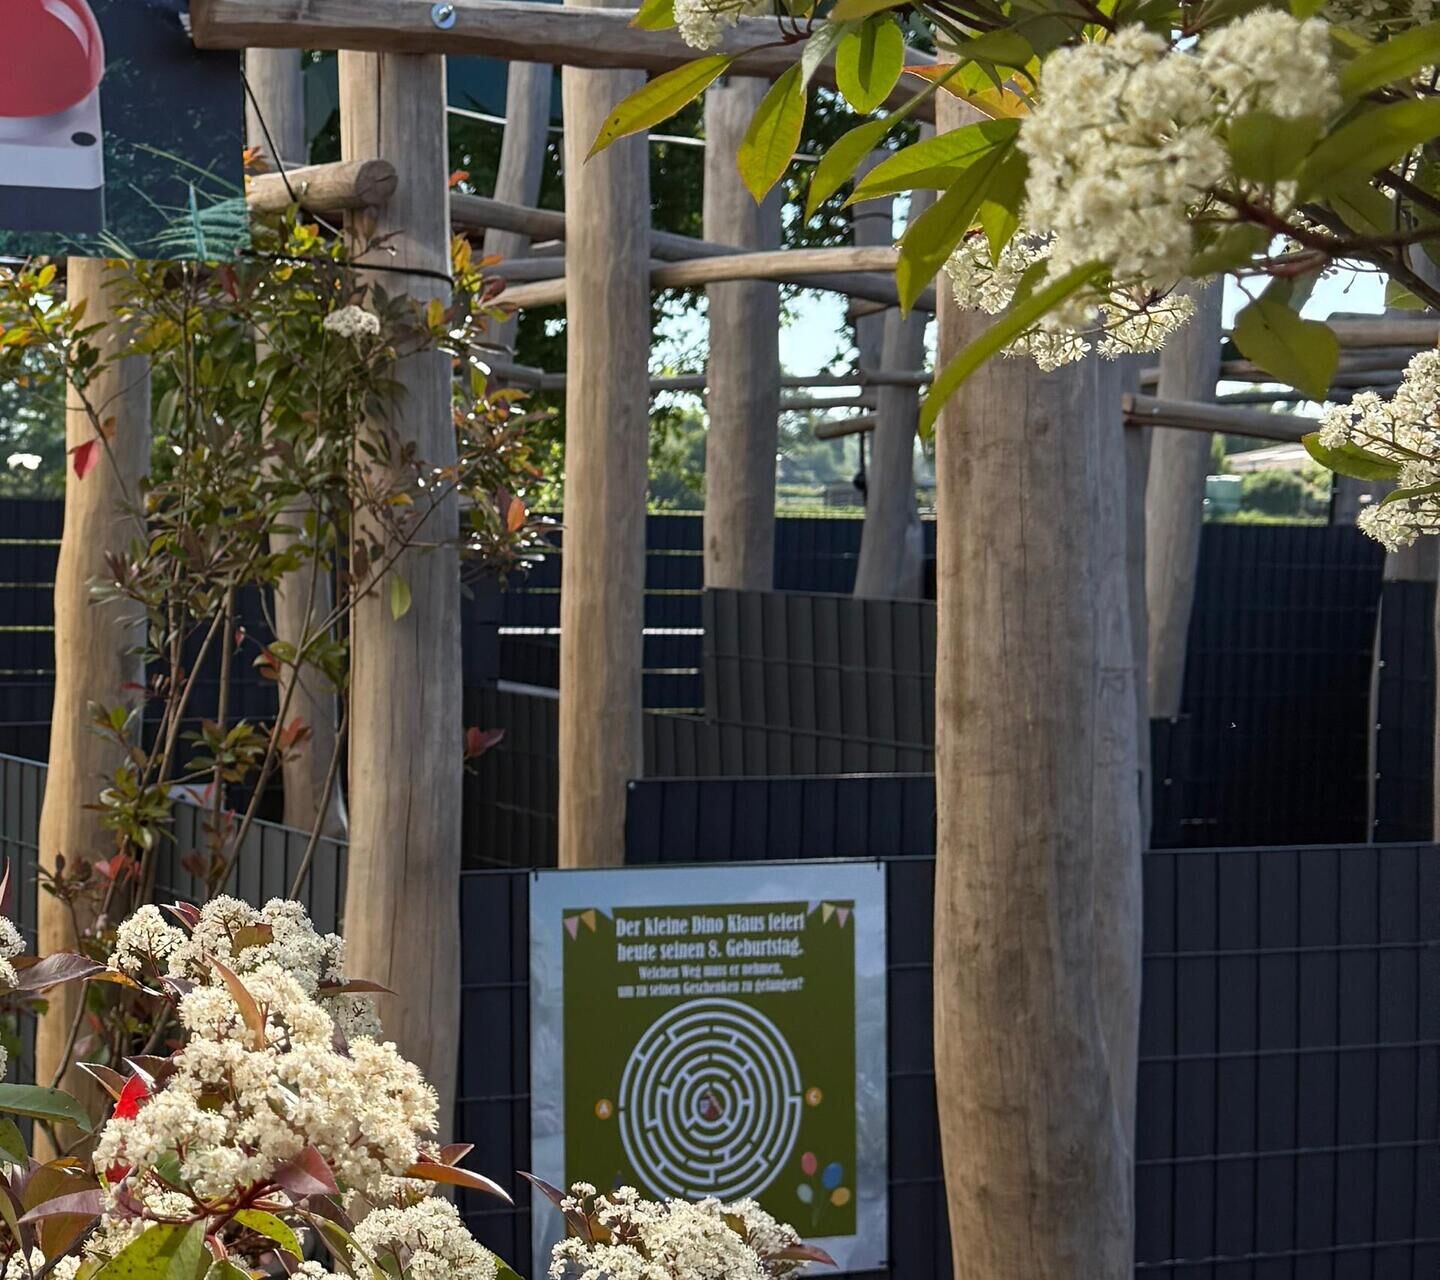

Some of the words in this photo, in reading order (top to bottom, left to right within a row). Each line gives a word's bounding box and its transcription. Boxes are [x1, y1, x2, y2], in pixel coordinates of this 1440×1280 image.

[616, 918, 641, 937] Der
[644, 917, 688, 936] kleine
[691, 915, 724, 935] Dino
[727, 914, 765, 933] Klaus
[768, 912, 805, 931] feiert
[617, 943, 657, 962] heute
[660, 941, 705, 960] seinen
[708, 940, 722, 958] 8.
[725, 936, 804, 957] Geburtstag.
